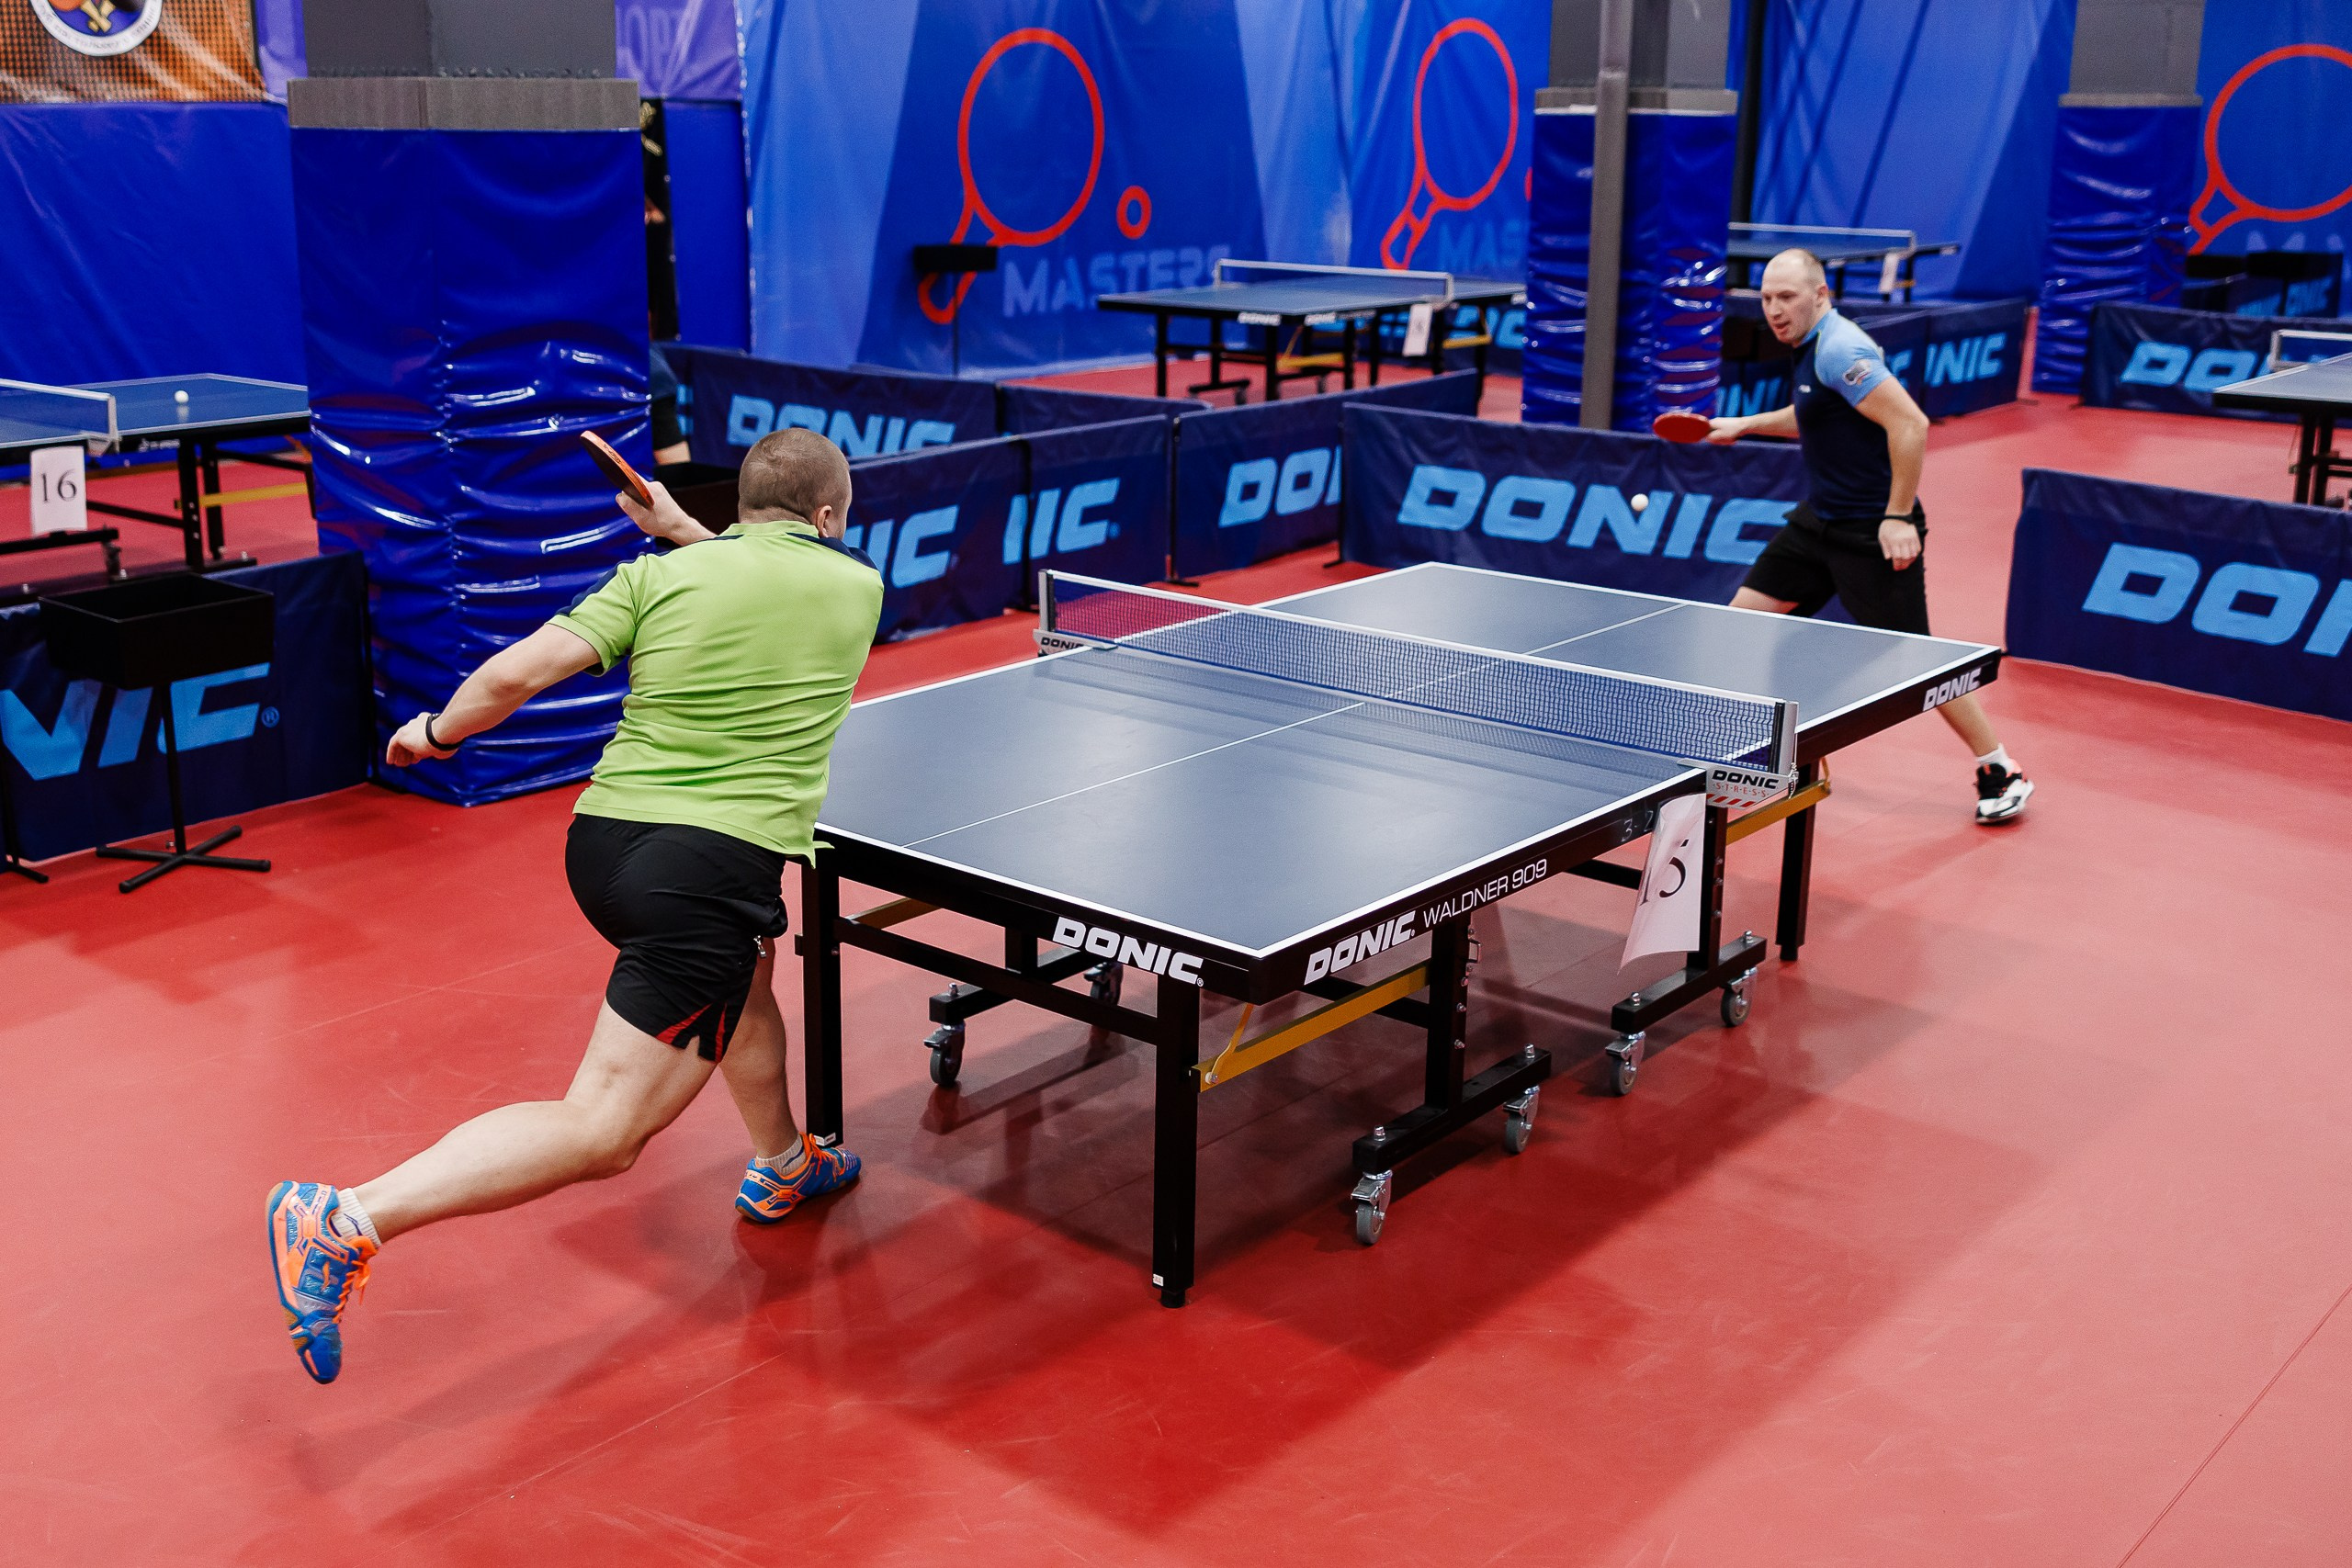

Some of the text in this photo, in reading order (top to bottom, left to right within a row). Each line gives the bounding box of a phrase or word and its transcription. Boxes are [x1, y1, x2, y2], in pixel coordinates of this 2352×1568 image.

[40, 468, 78, 503] 16
[1396, 465, 1802, 566] DONIC
[1922, 667, 1982, 712] DONIC
[1712, 770, 1780, 790] DONIC
[1423, 874, 1509, 929] WALDNER
[1511, 858, 1548, 890] 909
